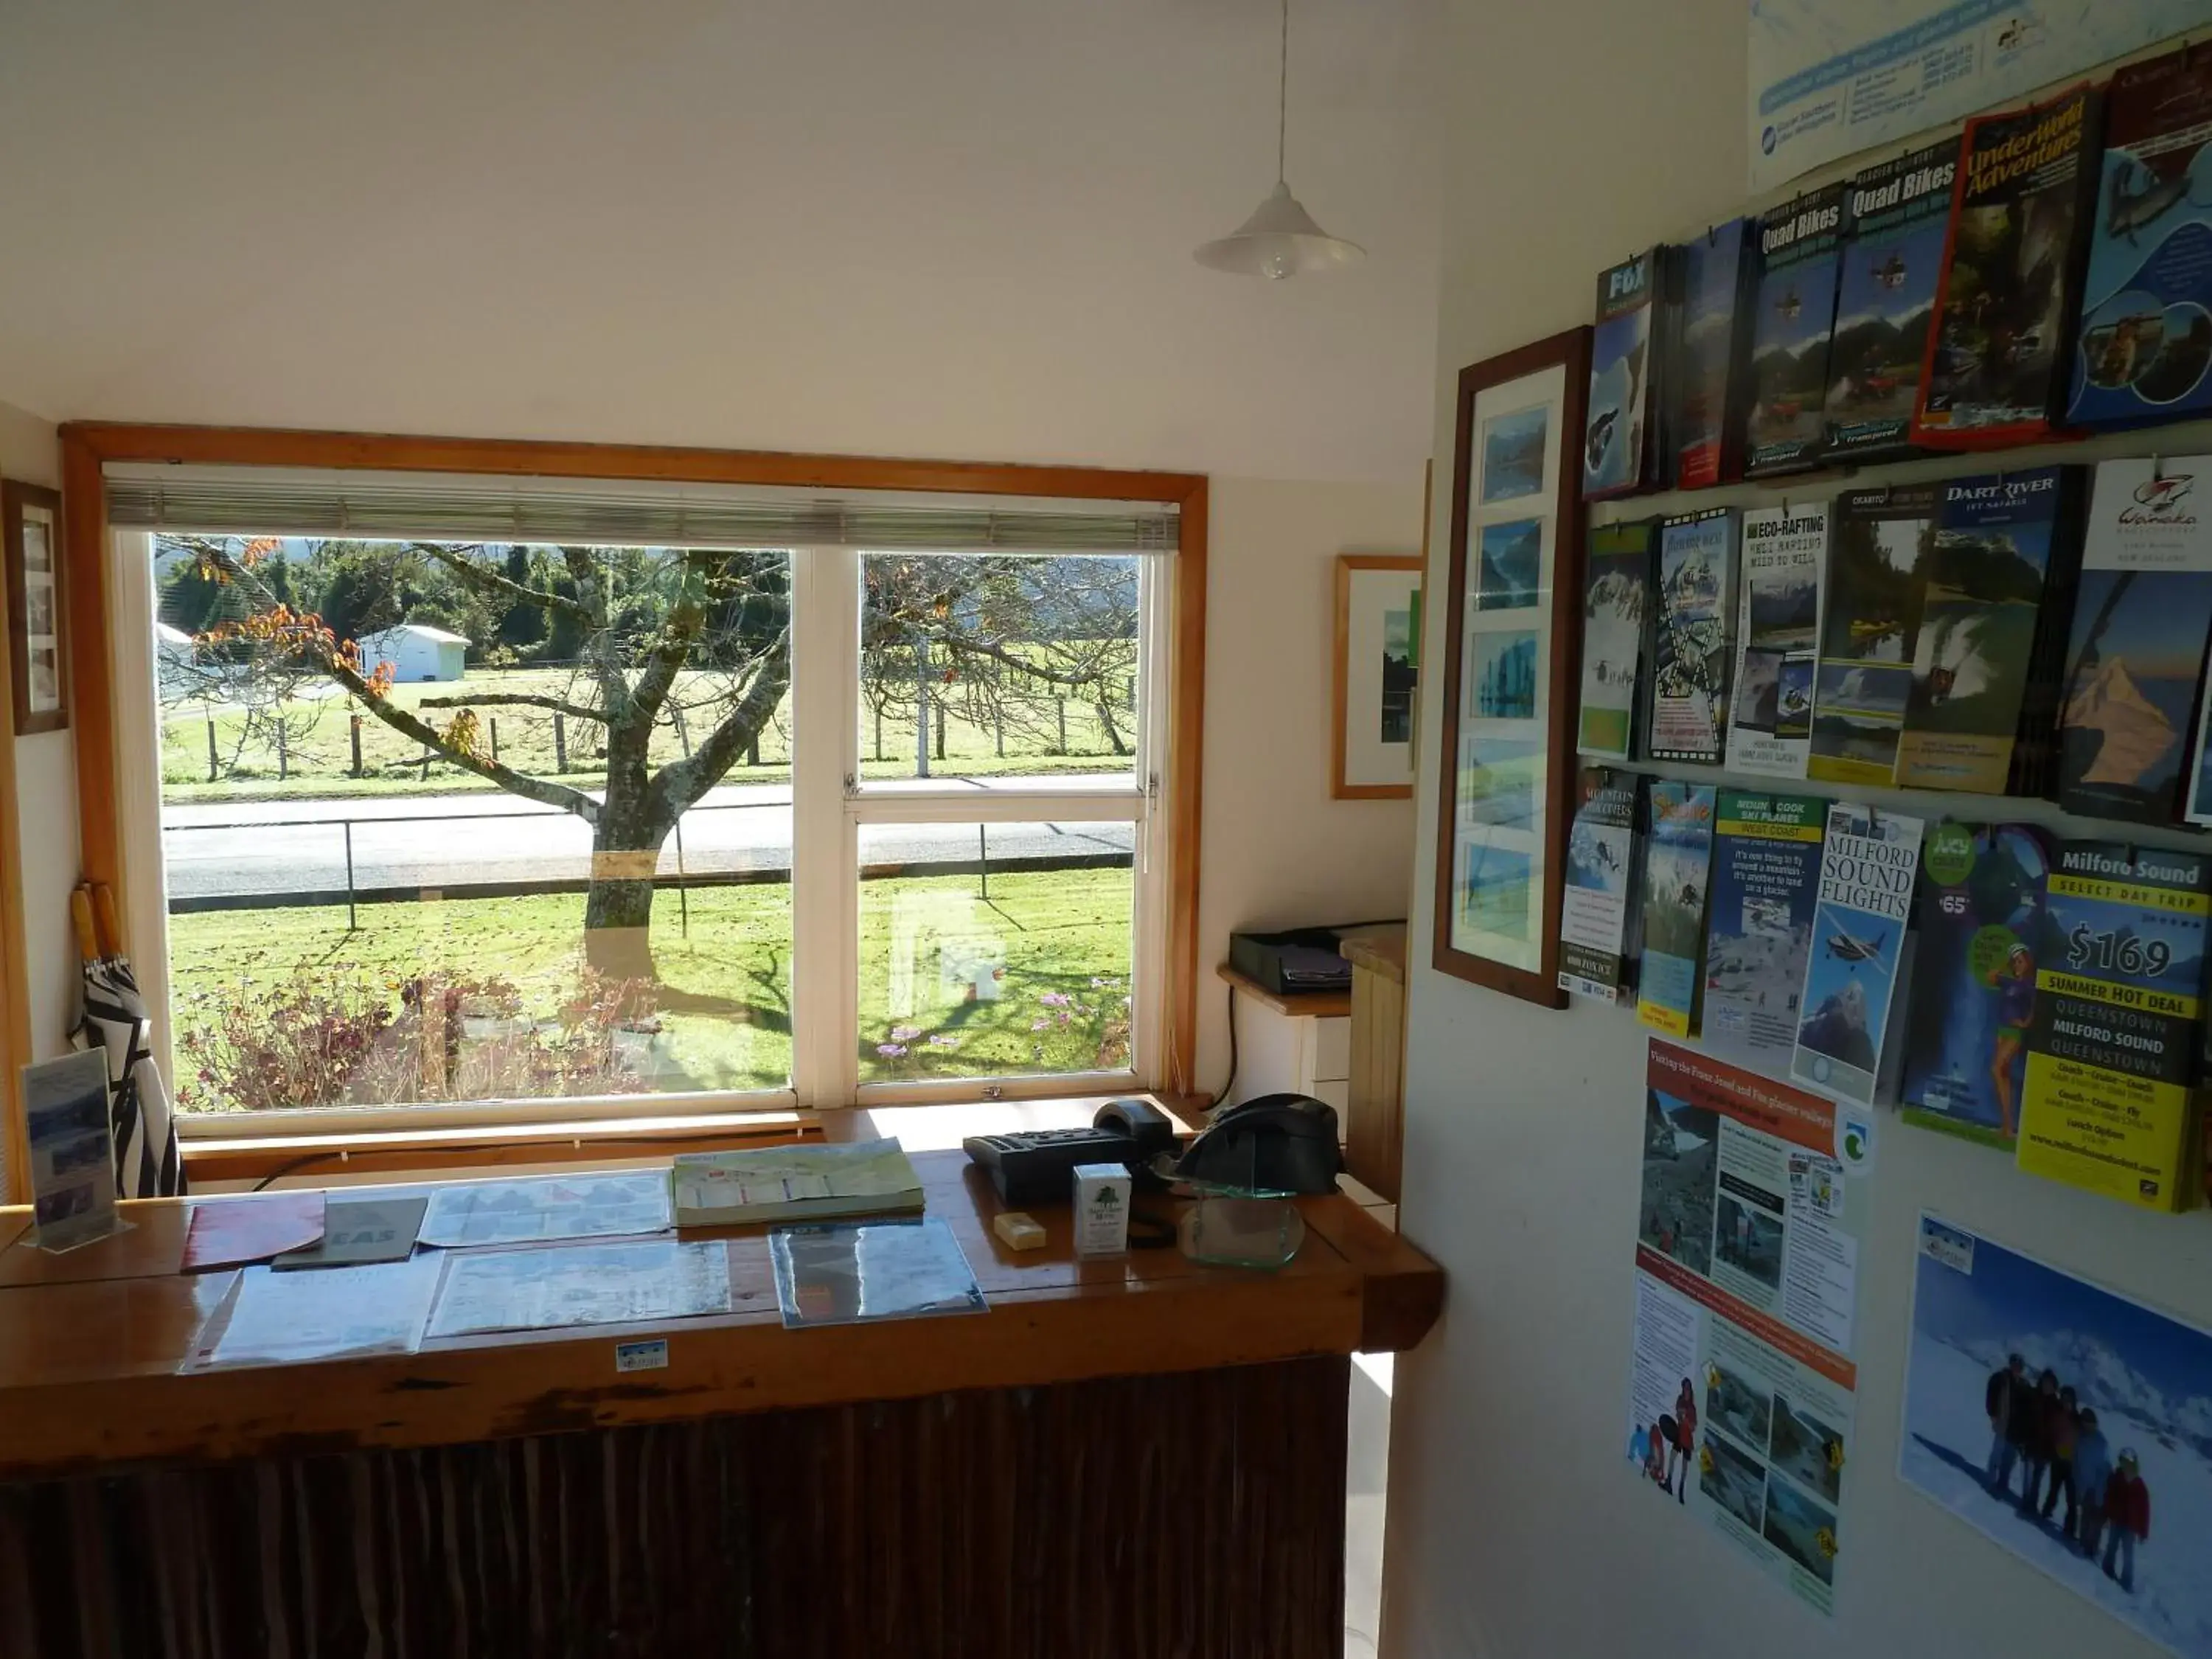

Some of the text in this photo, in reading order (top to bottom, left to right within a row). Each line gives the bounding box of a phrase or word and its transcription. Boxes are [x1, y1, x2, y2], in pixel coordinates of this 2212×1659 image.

[1852, 162, 1955, 218] Quad Bikes
[1762, 205, 1839, 254] Quad Bikes
[1947, 478, 2054, 501] DART RIVER
[1759, 516, 1823, 538] ECO-RAFTING
[1742, 823, 1801, 837] WEST COAST
[1828, 835, 1914, 869] MILFORD
[2062, 851, 2199, 884] Milford Sound
[1823, 855, 1910, 894] SOUND
[1822, 880, 1905, 918] FLIGHTS
[2059, 880, 2196, 908] SELECT DAY TRIP
[2066, 920, 2171, 978] $169
[2048, 975, 2185, 1013] SUMMER HOT DEAL
[2056, 1001, 2168, 1034] QUEENSTOWN
[2053, 1018, 2164, 1054] MILFORD SOUND
[2051, 1040, 2161, 1075] QUEENSTOWN
